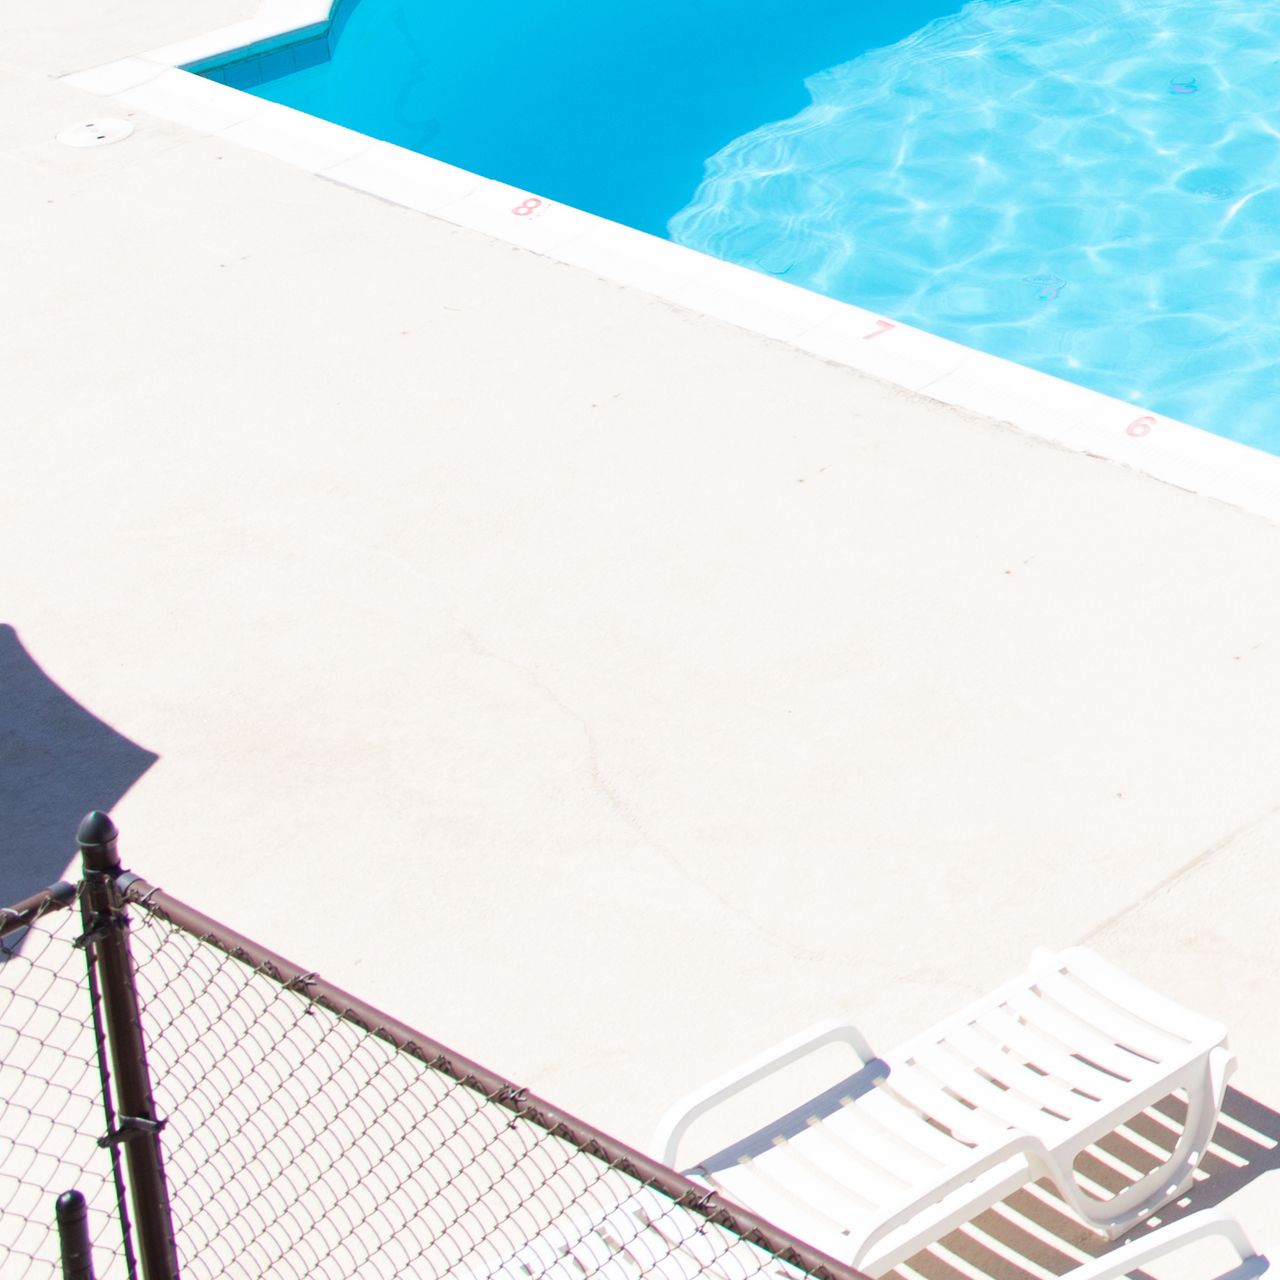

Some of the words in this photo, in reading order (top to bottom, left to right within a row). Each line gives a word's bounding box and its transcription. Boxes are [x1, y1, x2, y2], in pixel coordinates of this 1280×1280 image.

[511, 197, 542, 216] 8
[862, 319, 897, 340] 7
[1126, 415, 1158, 438] 6
